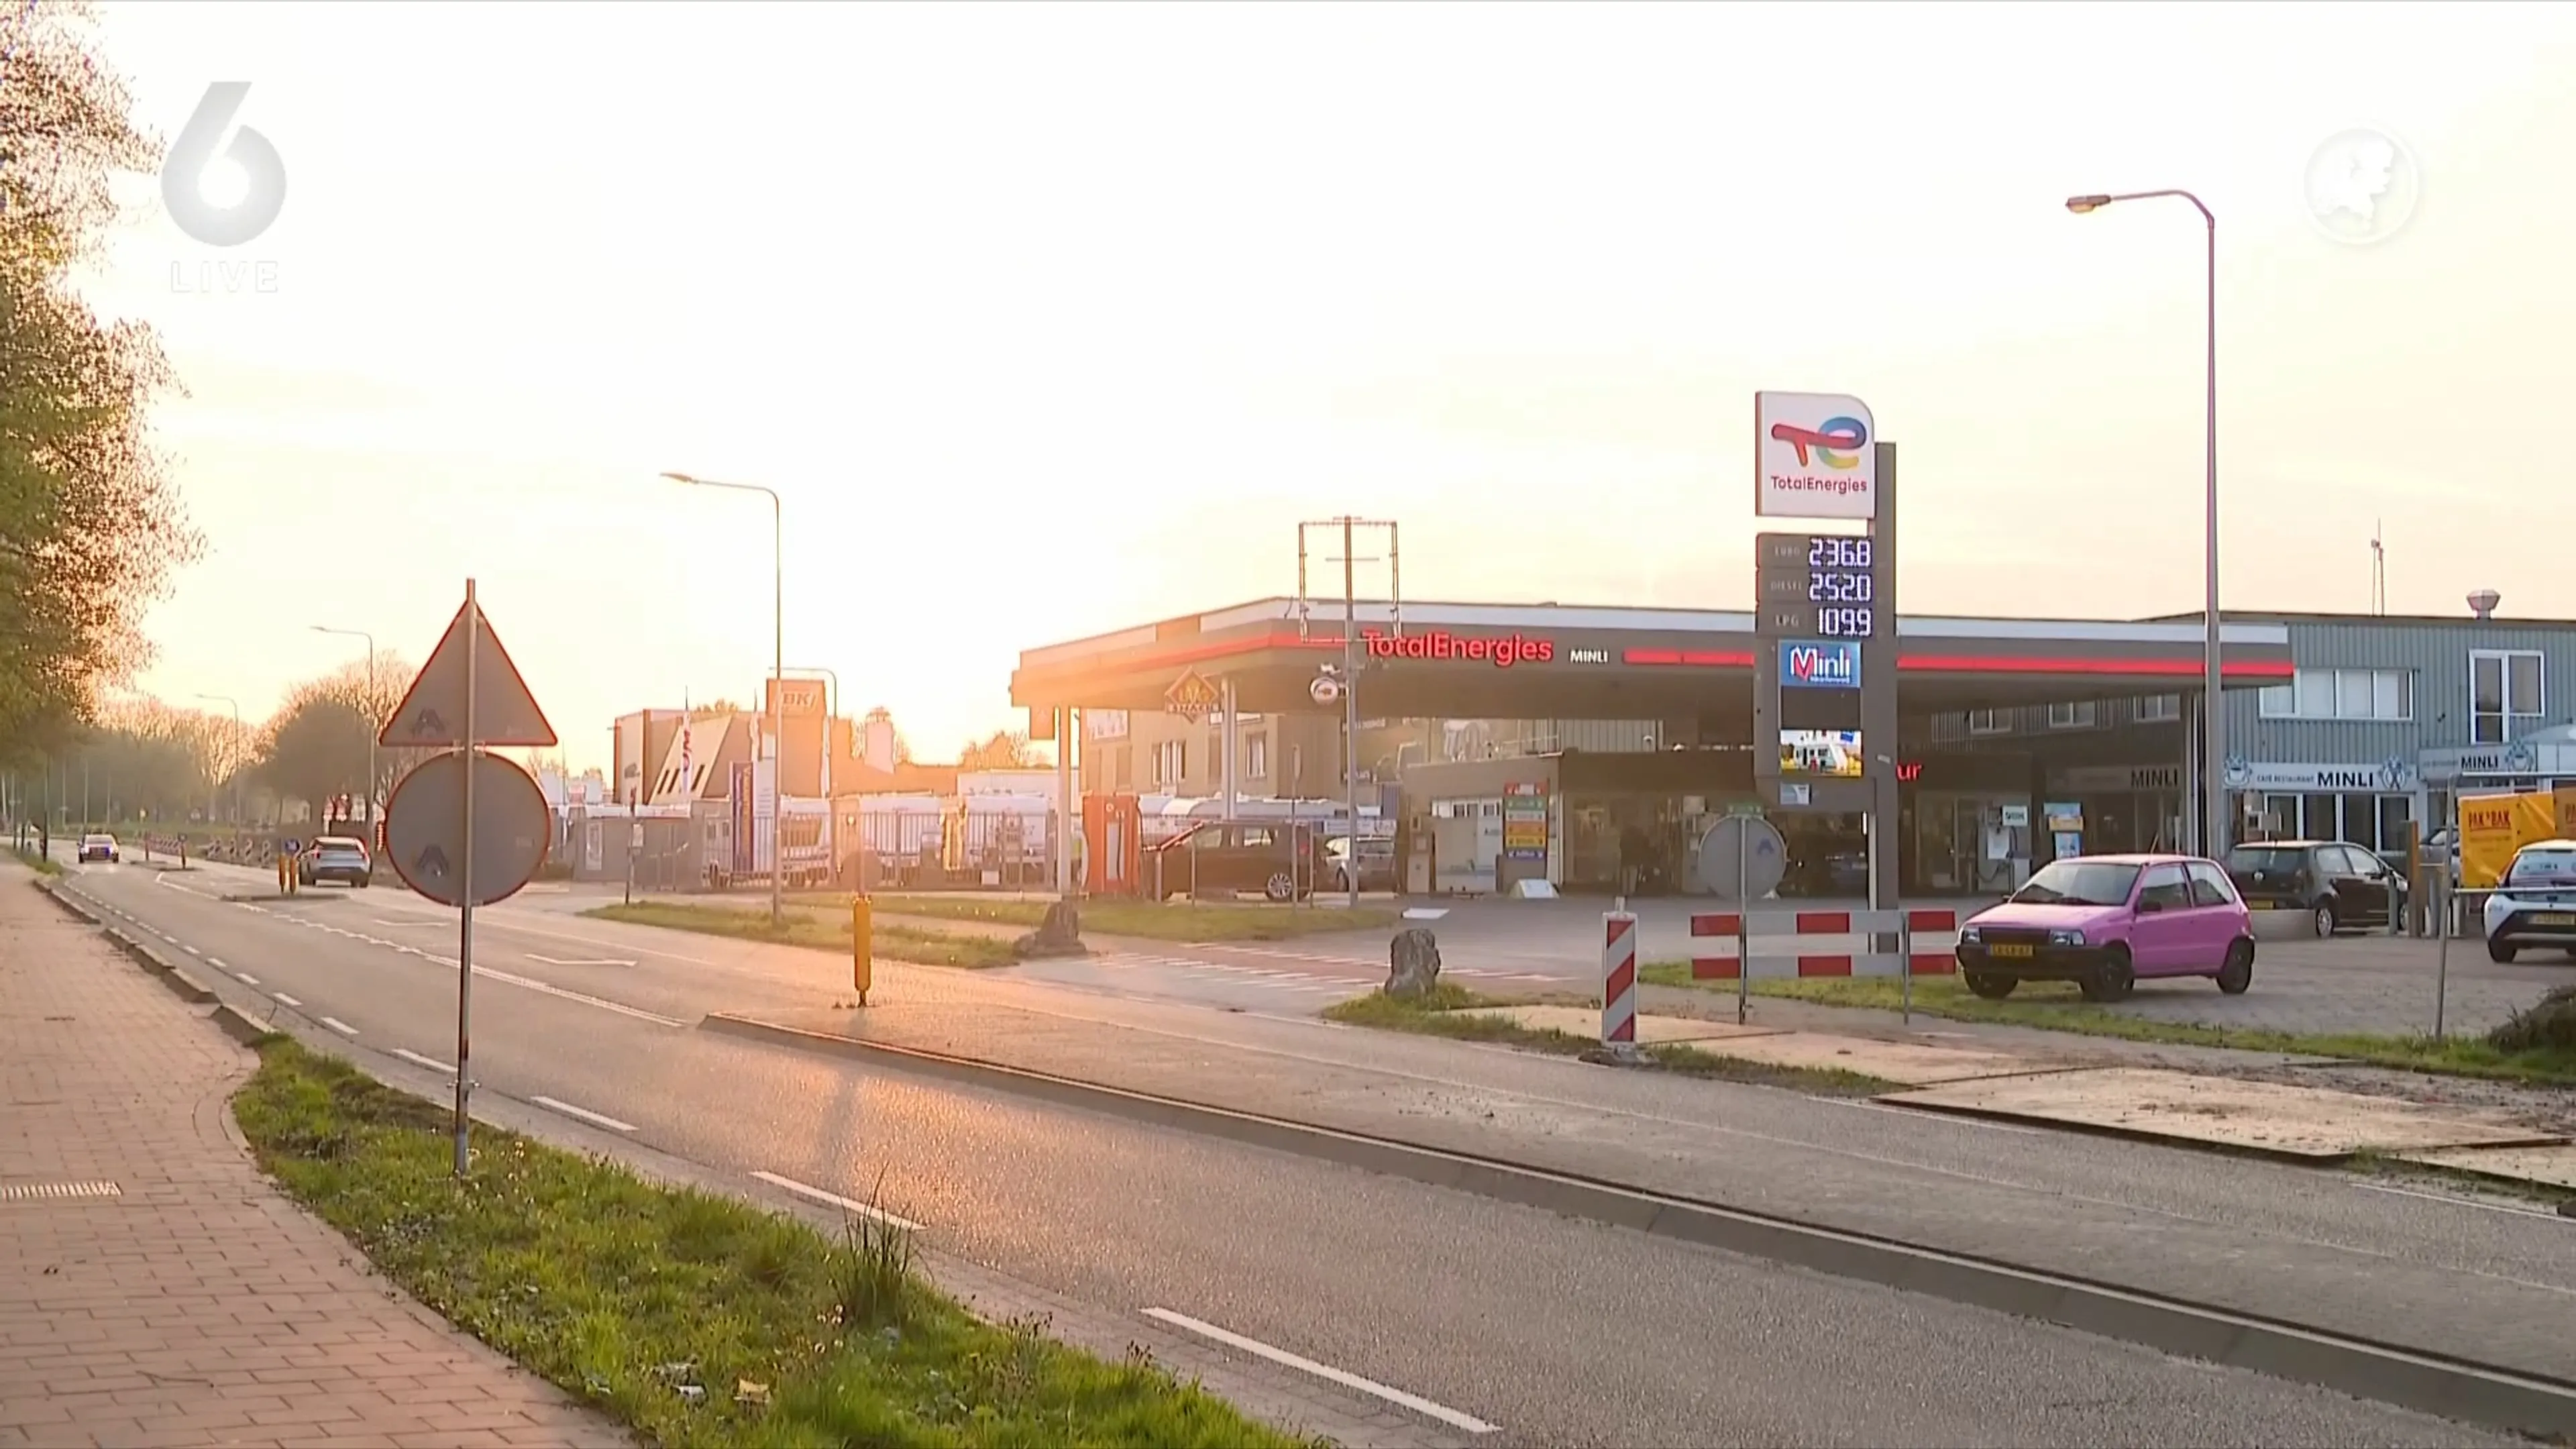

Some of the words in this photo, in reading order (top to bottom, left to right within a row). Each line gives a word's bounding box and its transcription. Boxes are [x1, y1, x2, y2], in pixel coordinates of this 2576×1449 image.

[1770, 476, 1867, 495] TotalEnergies
[1775, 614, 1799, 627] LPG
[1361, 629, 1553, 666] TotalEnergies
[1569, 649, 1608, 663] MINLI
[1790, 646, 1850, 678] Minli
[2461, 755, 2499, 769] MINLI
[2131, 768, 2178, 788] MINLI
[2318, 771, 2373, 788] MINLI
